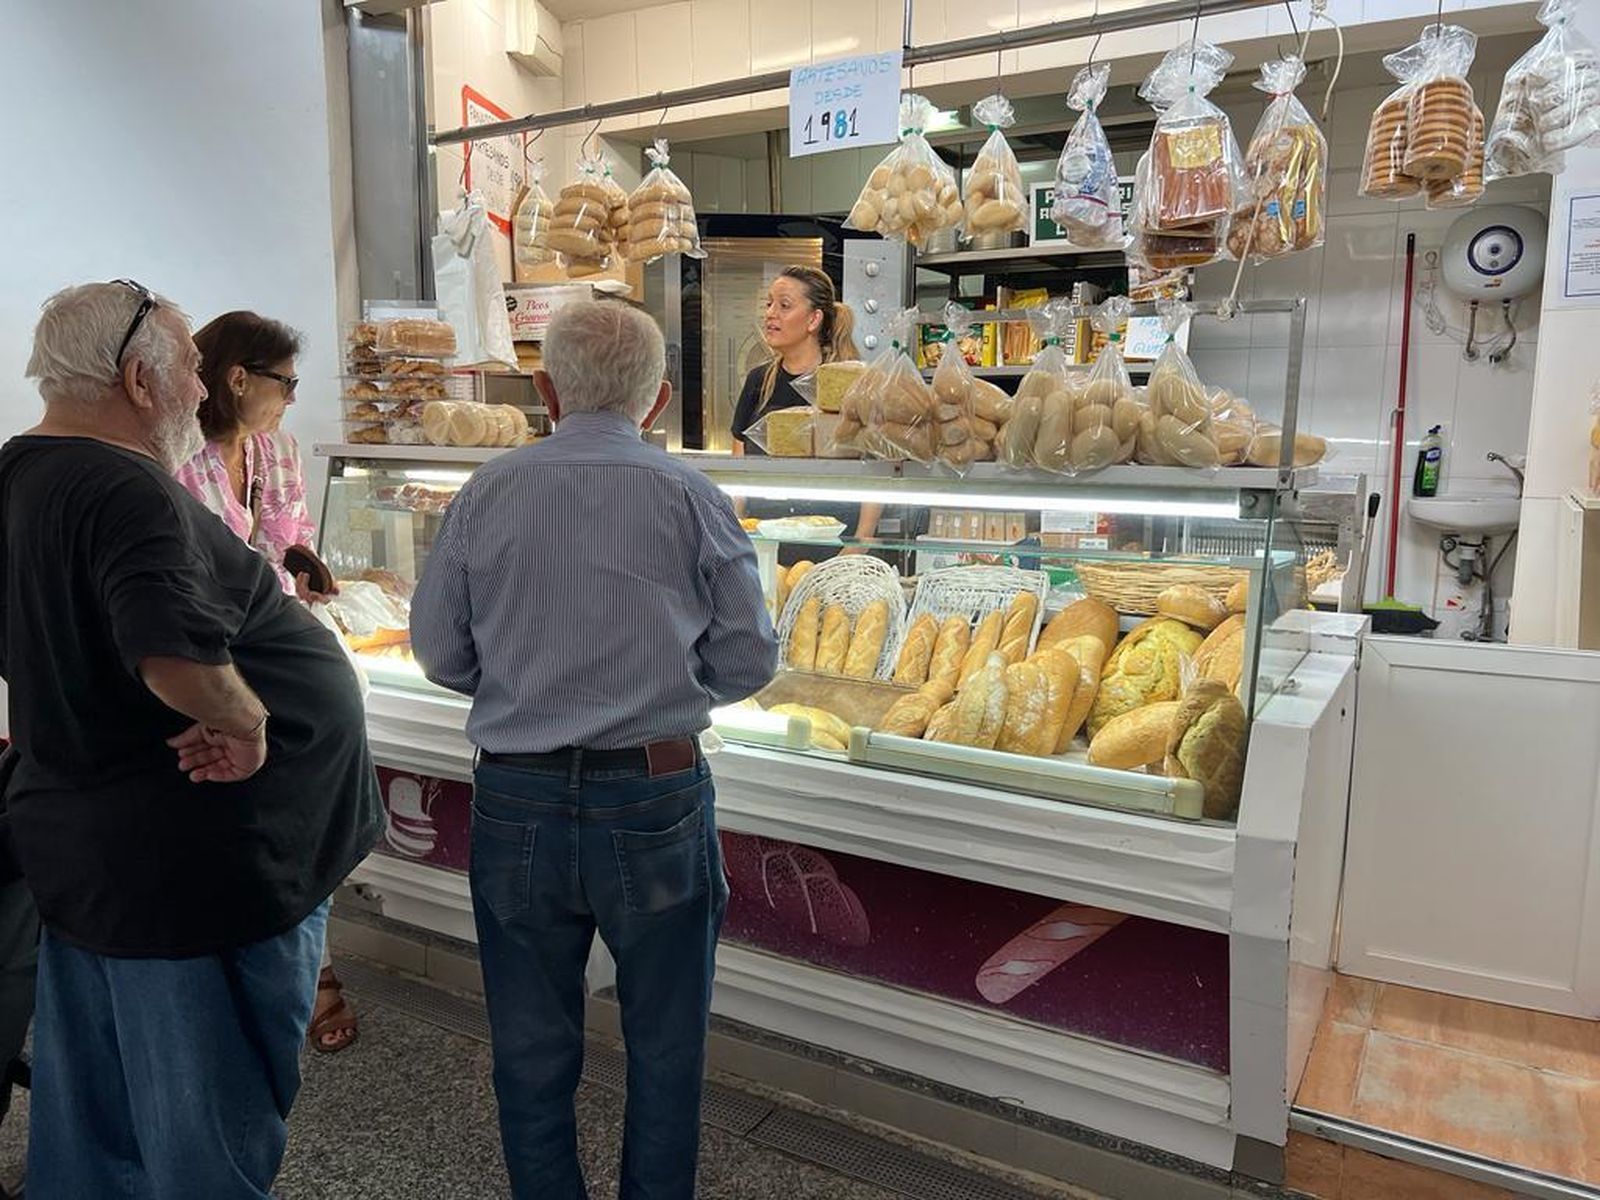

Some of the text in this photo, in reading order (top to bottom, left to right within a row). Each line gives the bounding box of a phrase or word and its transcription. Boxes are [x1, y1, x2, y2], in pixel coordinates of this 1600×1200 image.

[795, 57, 891, 87] ARTESANOS
[814, 84, 863, 105] DESDE
[802, 107, 860, 145] 1981
